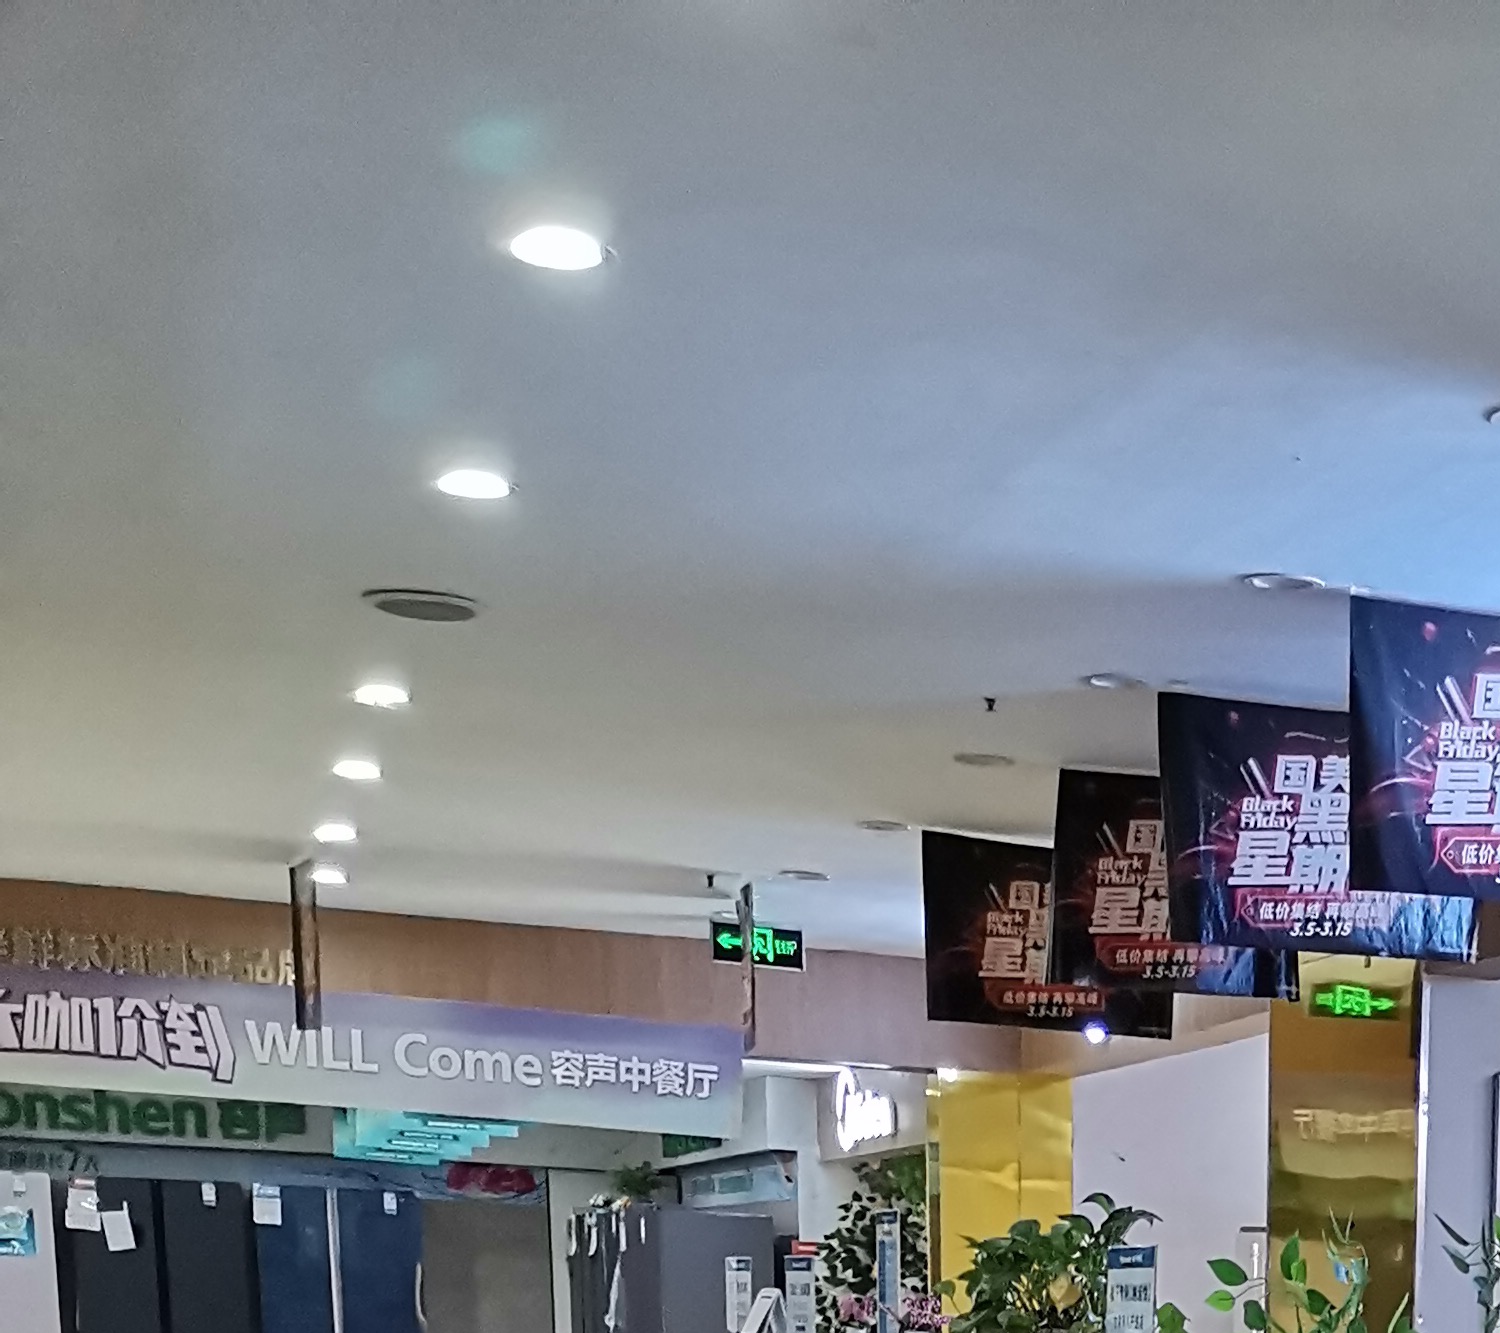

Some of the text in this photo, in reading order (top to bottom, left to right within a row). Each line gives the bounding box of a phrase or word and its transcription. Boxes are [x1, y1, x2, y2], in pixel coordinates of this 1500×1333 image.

[1439, 721, 1496, 741] Black
[1437, 740, 1500, 762] Friday
[1241, 797, 1294, 813] Black
[1240, 811, 1298, 832] Friday
[1097, 856, 1144, 872] Black
[1096, 870, 1148, 887] Friday
[1289, 922, 1352, 938] 3.5-3.15
[1142, 965, 1197, 979] 3.5-3.15
[244, 1018, 379, 1075] WILL
[393, 1031, 544, 1088] Come
[551, 1050, 721, 1100] 容声中餐厅
